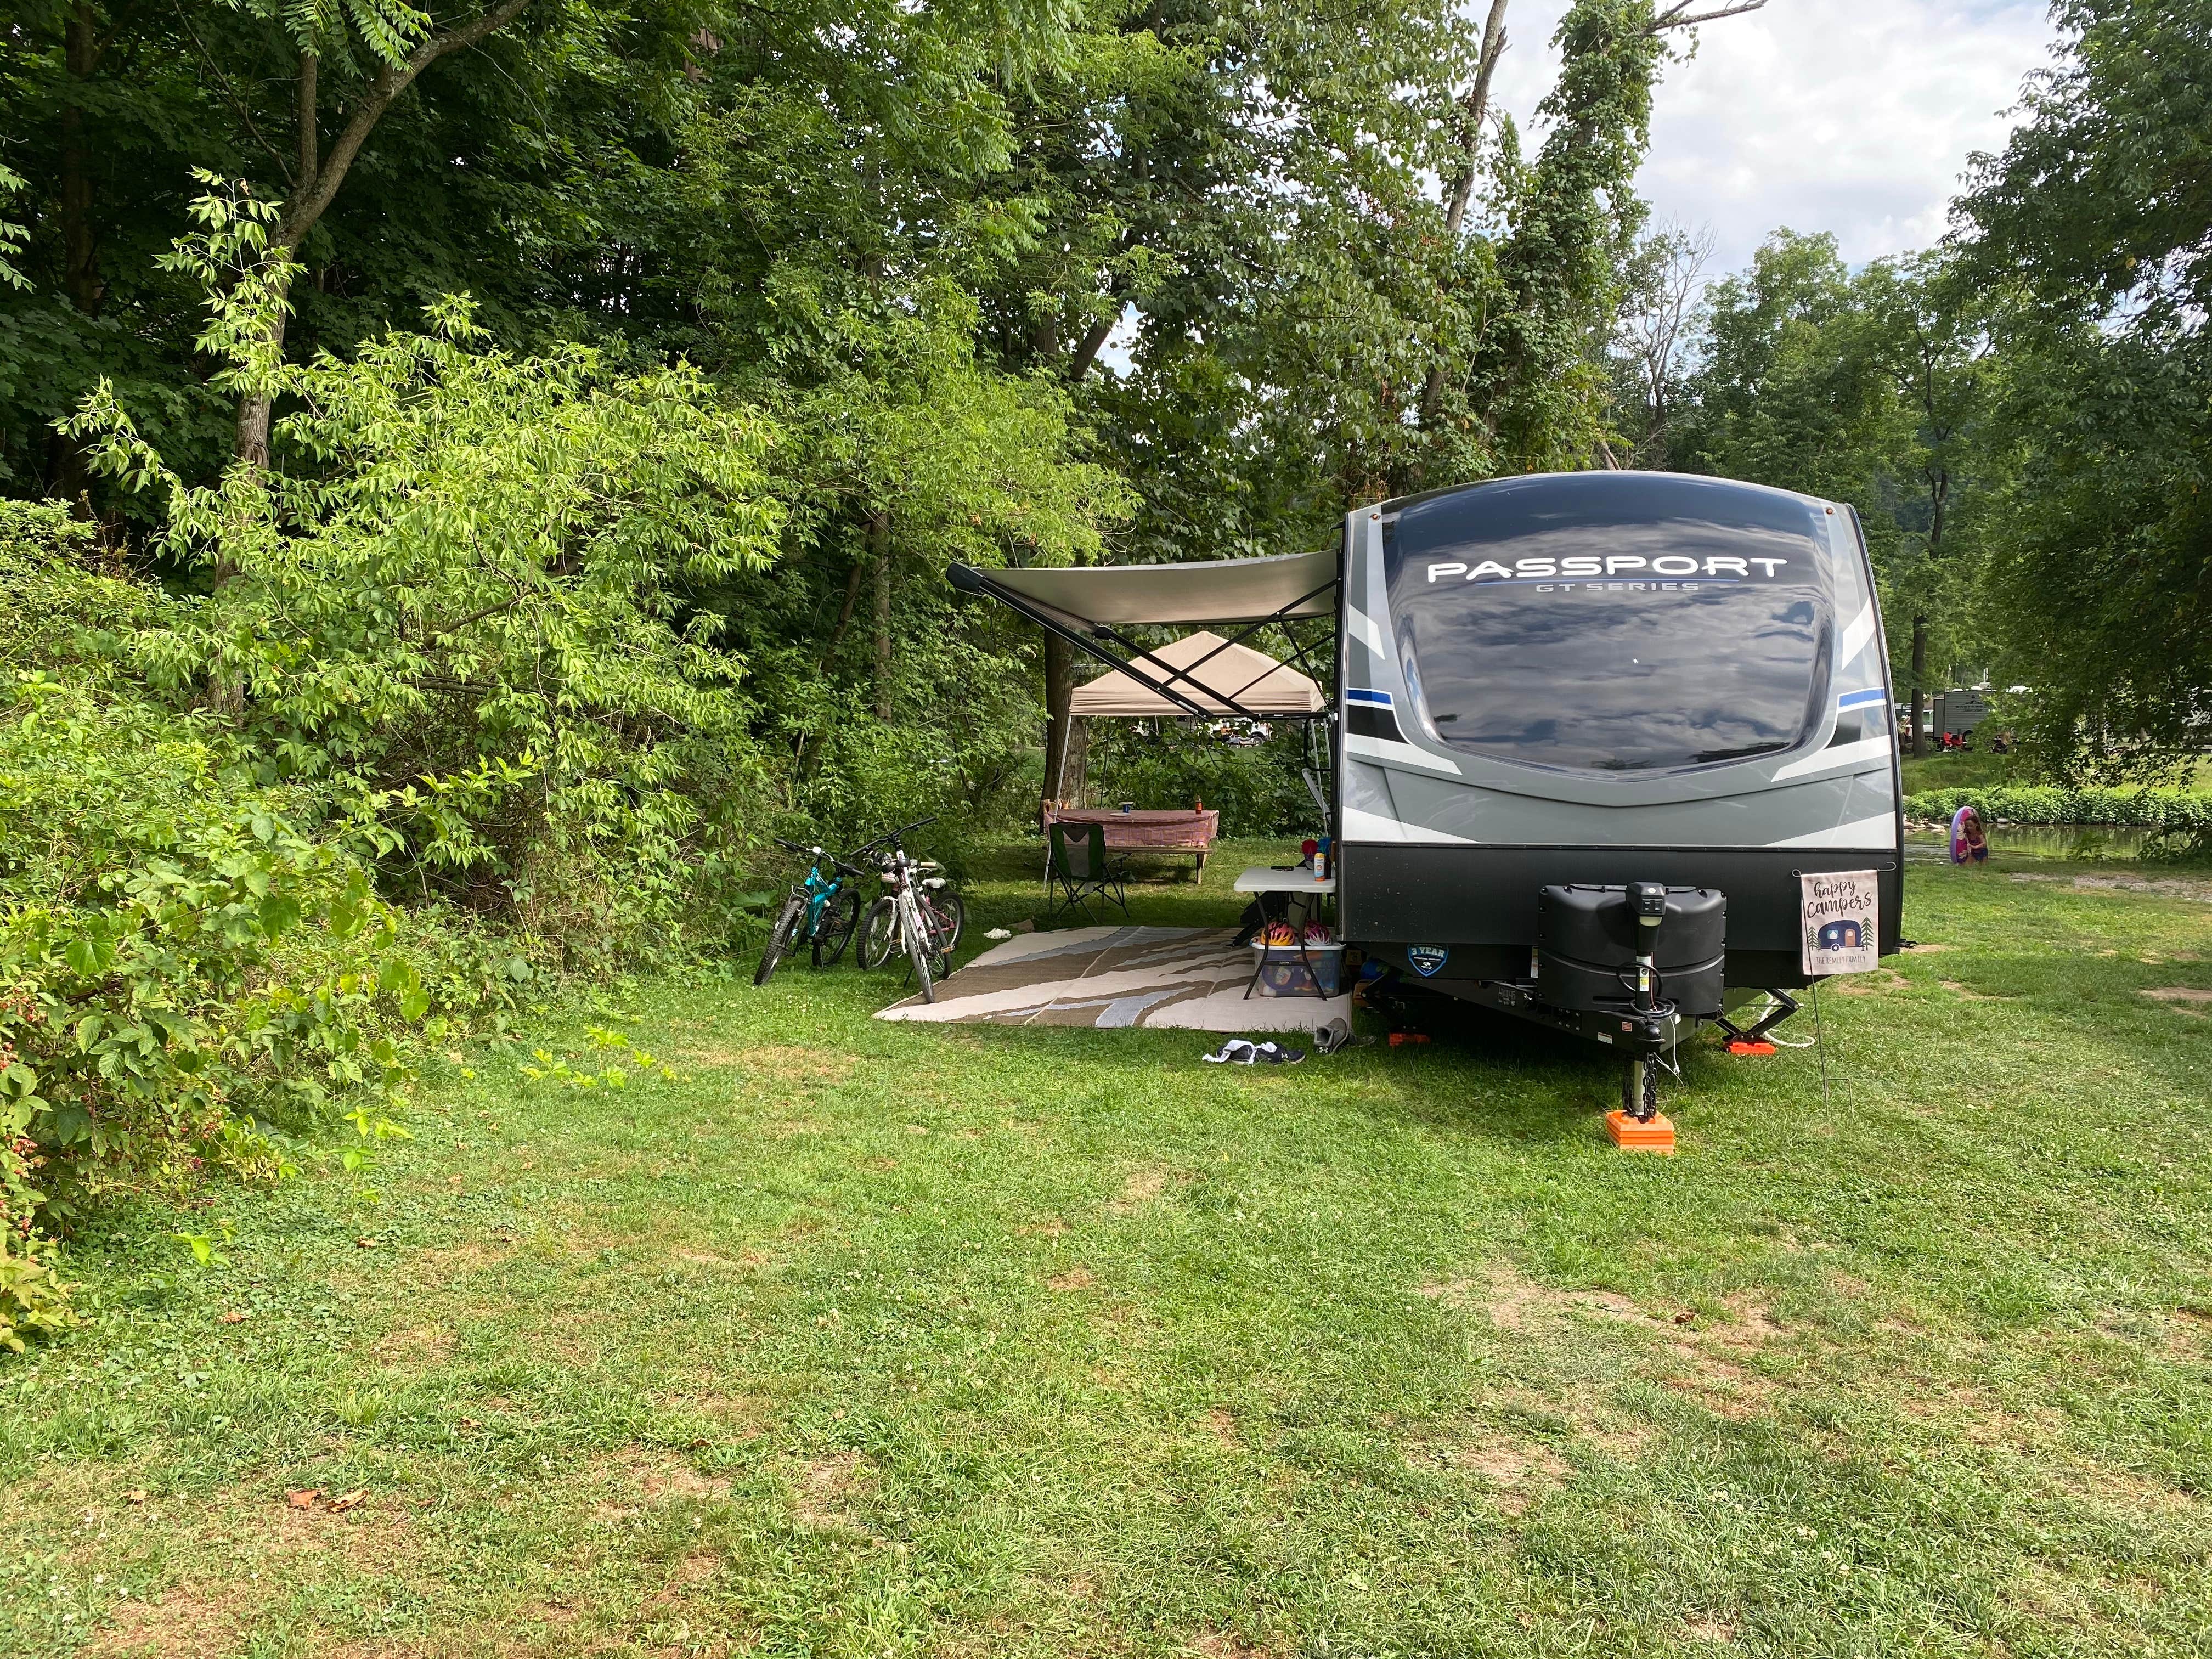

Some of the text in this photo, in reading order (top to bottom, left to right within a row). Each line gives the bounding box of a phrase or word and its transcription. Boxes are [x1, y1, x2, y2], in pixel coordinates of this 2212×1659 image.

[1427, 556, 1787, 583] PASSPORT
[1536, 582, 1700, 592] GT SERIES
[1814, 881, 1856, 899] happy
[1807, 891, 1873, 918] campers
[1419, 947, 1444, 957] YEAR
[1846, 955, 1866, 963] FAMILY
